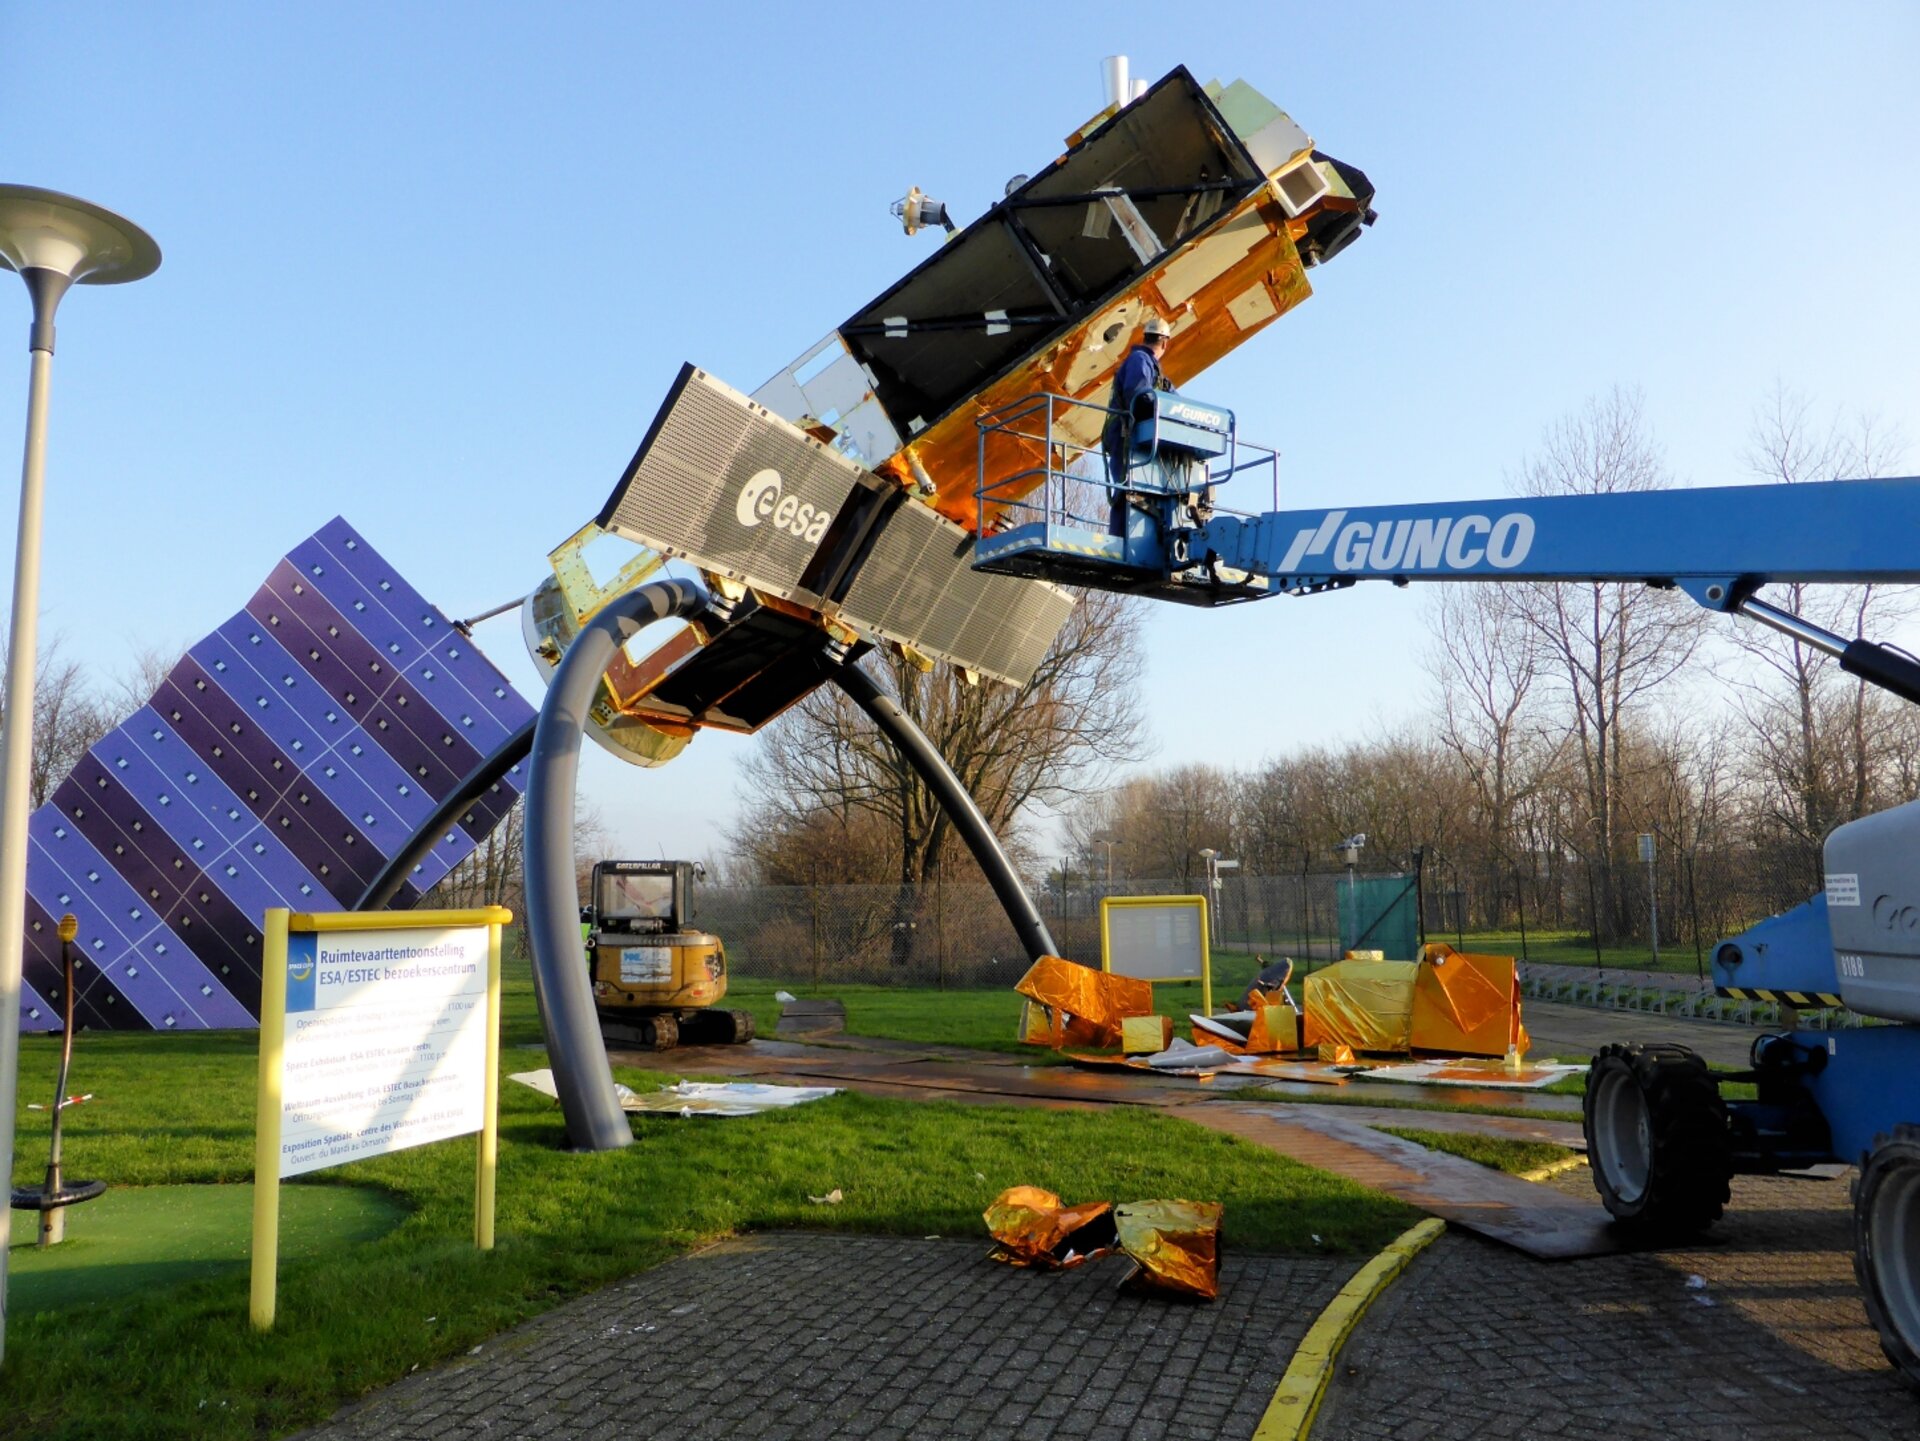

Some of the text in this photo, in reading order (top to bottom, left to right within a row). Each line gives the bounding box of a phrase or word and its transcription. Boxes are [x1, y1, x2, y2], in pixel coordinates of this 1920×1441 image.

[1181, 407, 1221, 426] GUNCO
[1333, 512, 1536, 572] GUNCO
[321, 943, 464, 964] Ruimtevaarttentoonstelling
[319, 960, 476, 986] ESA/ESTEC bezoekerscentrum
